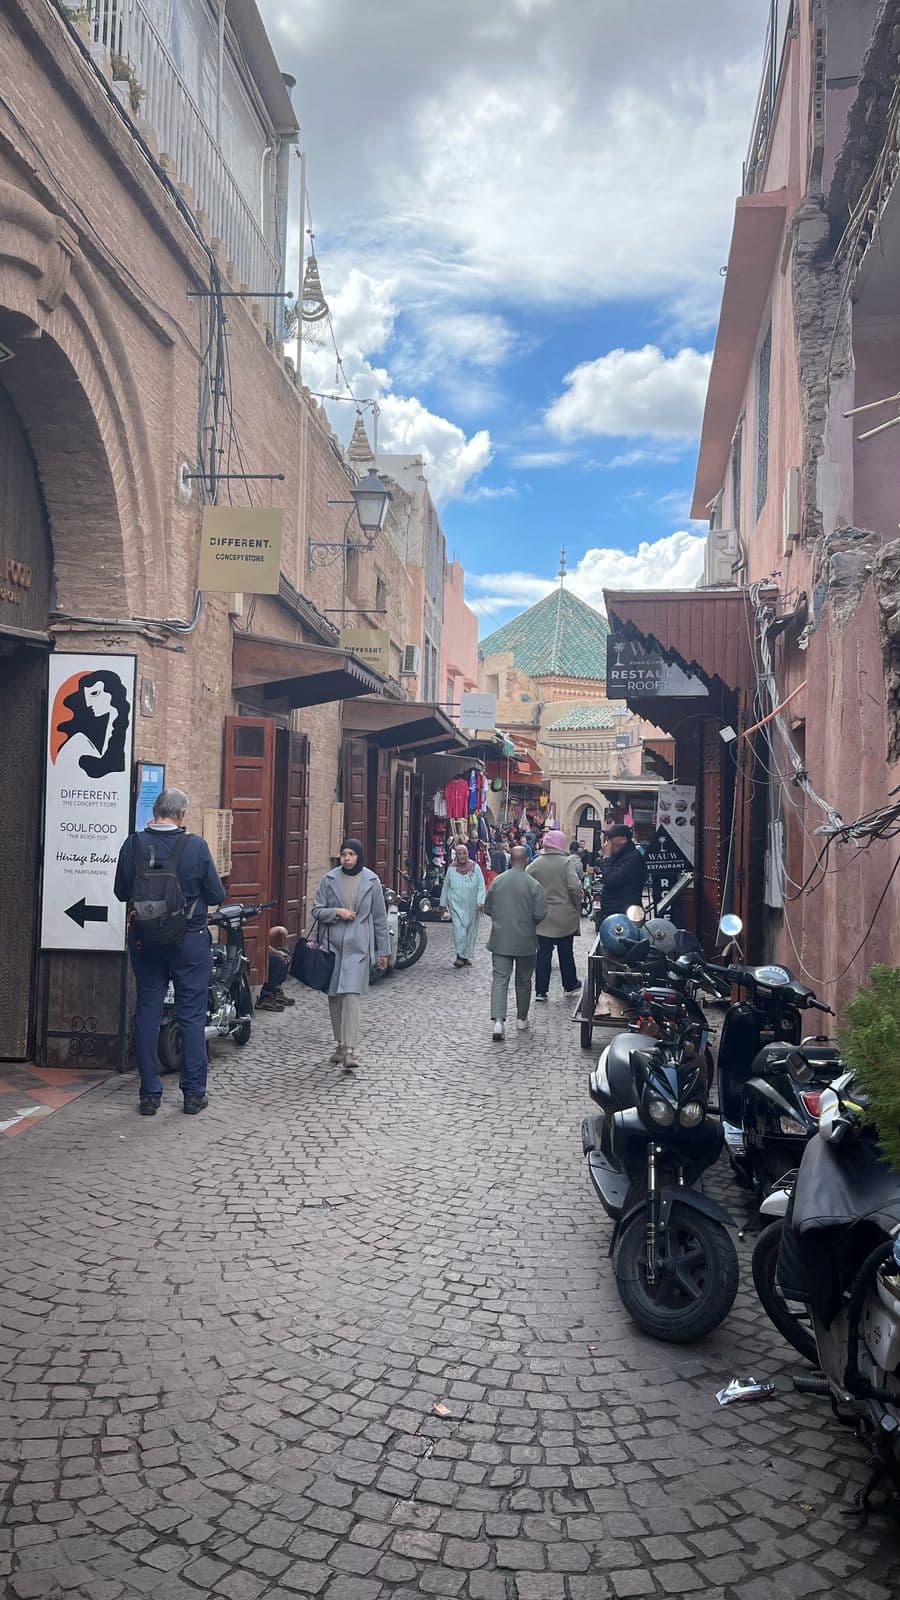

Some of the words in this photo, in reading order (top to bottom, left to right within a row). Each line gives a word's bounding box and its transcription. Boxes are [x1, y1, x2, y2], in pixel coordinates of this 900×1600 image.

[210, 537, 272, 548] DIFFERENT.
[215, 553, 243, 561] CONCEPT
[244, 554, 265, 562] STORE
[60, 789, 119, 801] DIFFERENT.
[60, 822, 87, 833] SOUL
[88, 823, 118, 834] FOOD
[648, 852, 678, 860] WAUW
